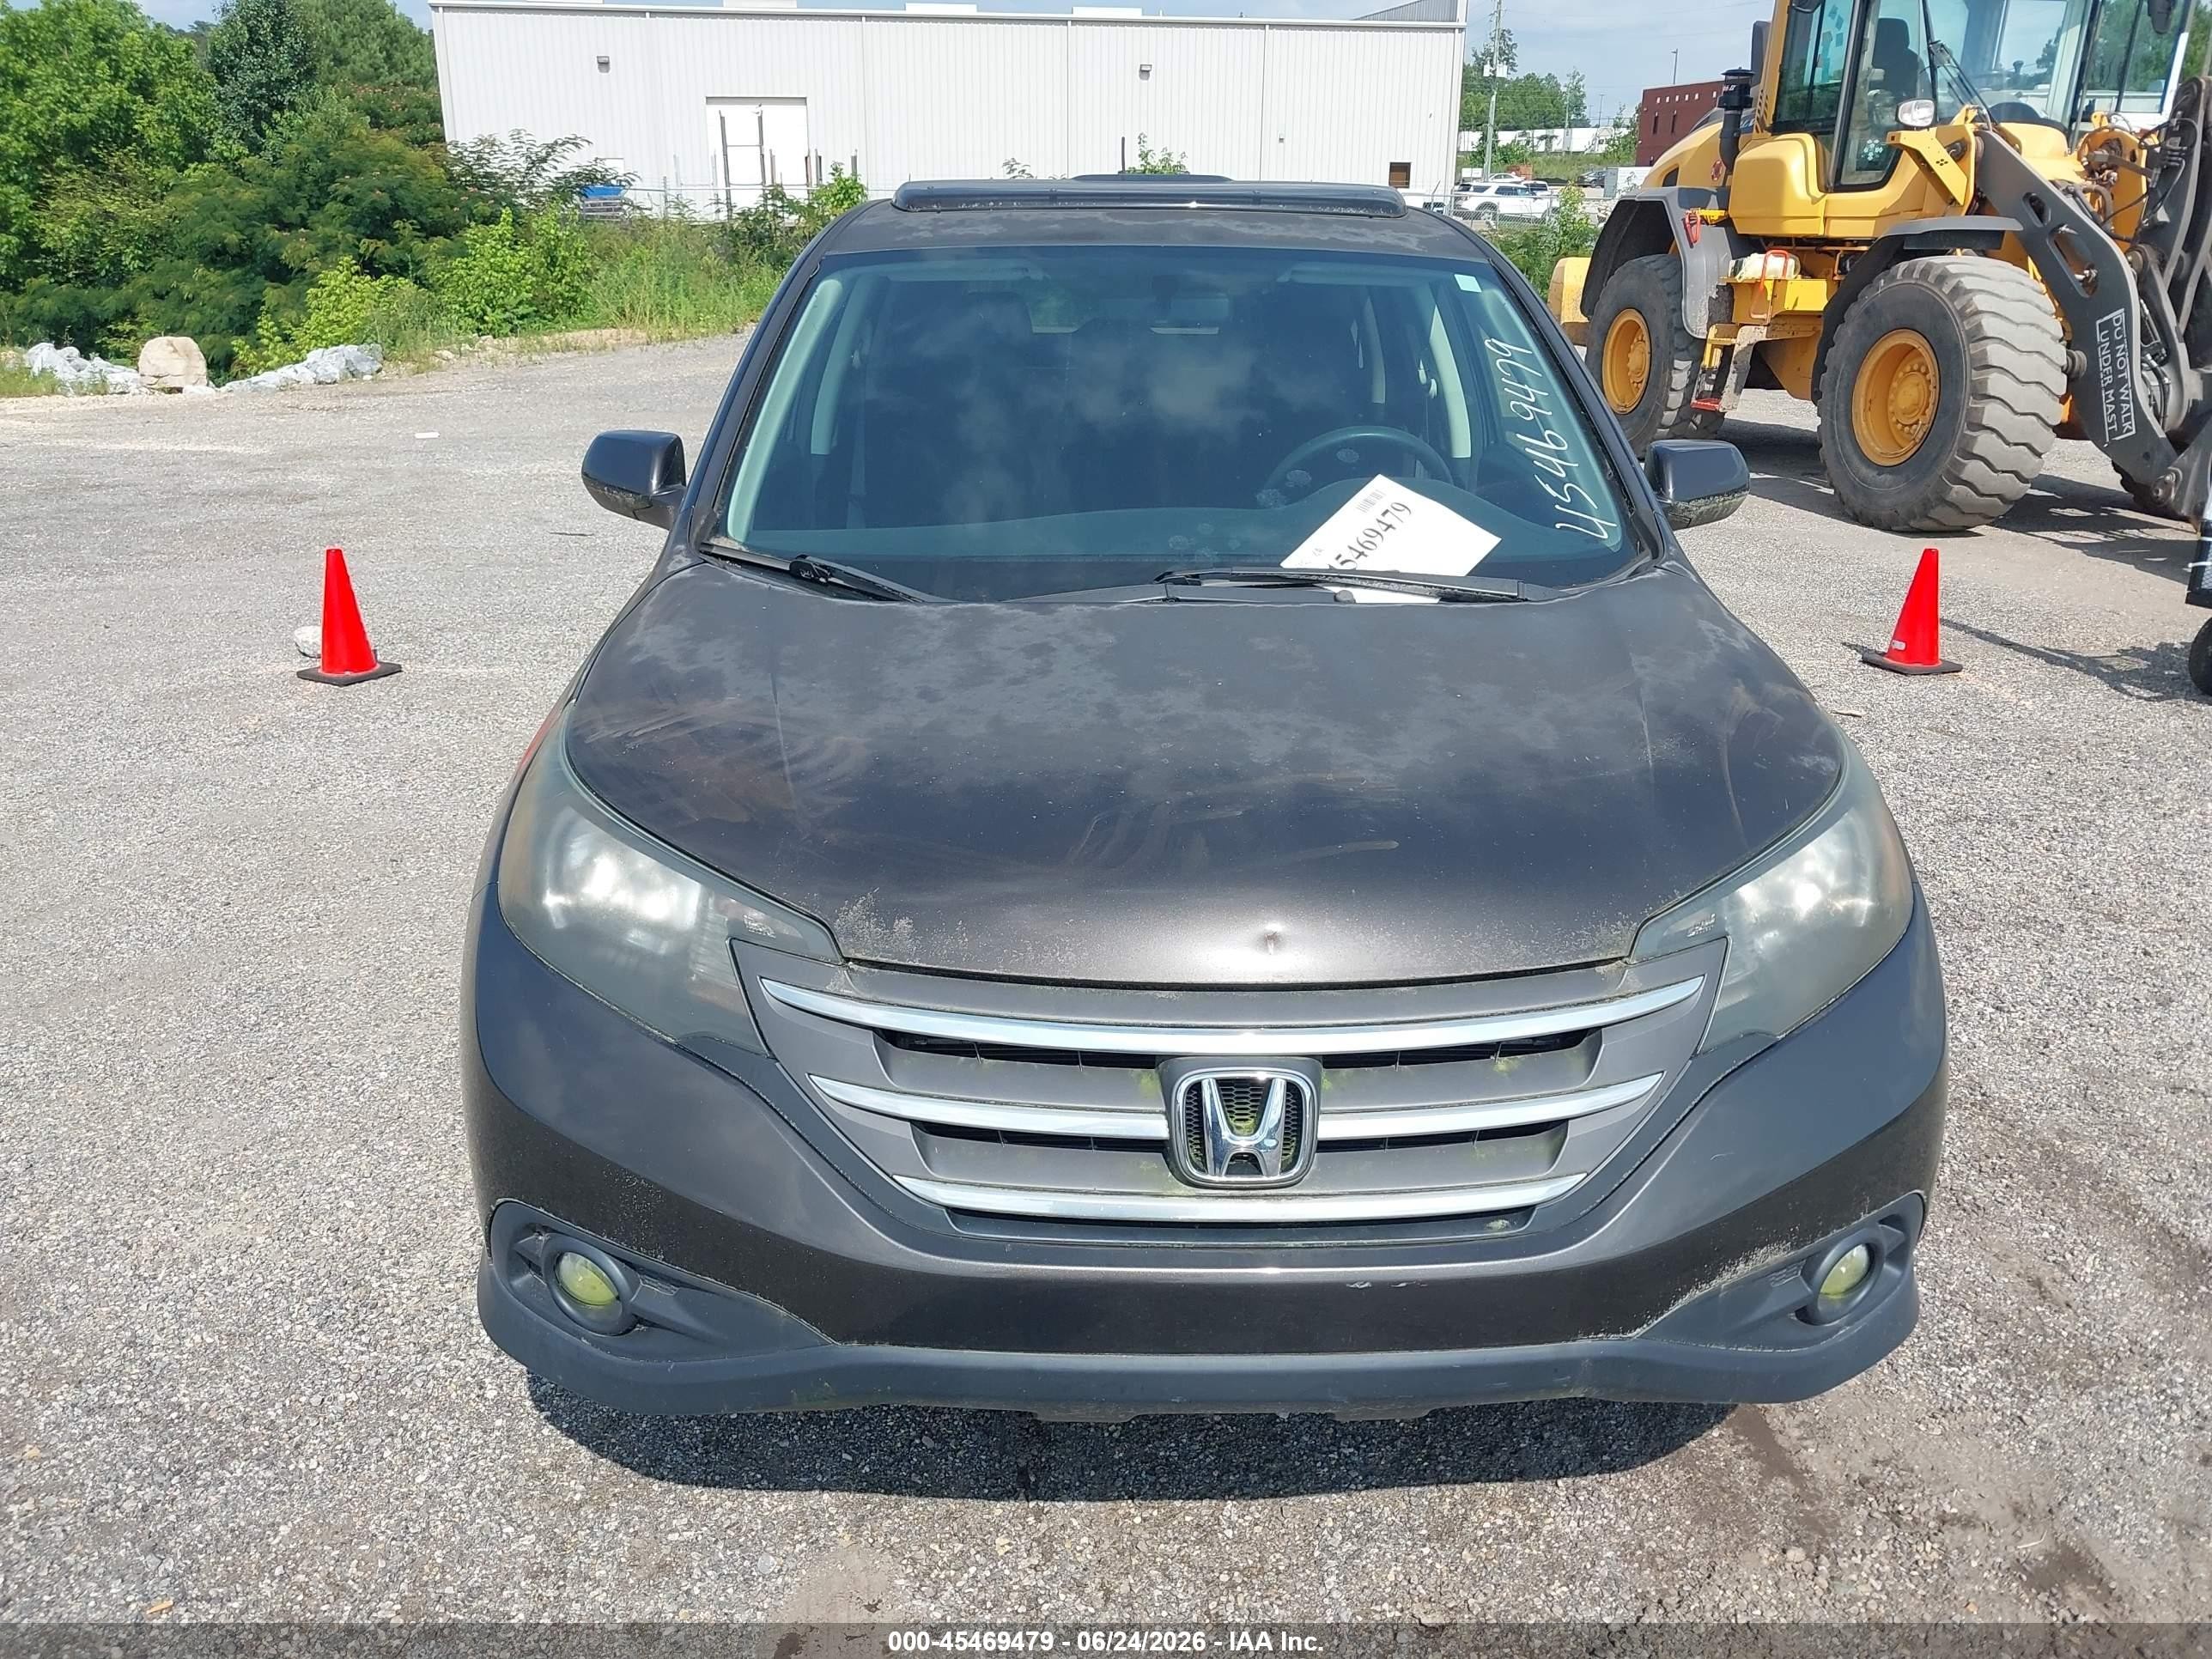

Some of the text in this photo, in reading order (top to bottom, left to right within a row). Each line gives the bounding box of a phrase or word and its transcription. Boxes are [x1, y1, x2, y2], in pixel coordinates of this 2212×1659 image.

[2100, 330, 2118, 432] UNDER MAST
[2116, 343, 2128, 380] NOT
[2119, 383, 2133, 433] WALK
[1328, 501, 1413, 570] 5469479
